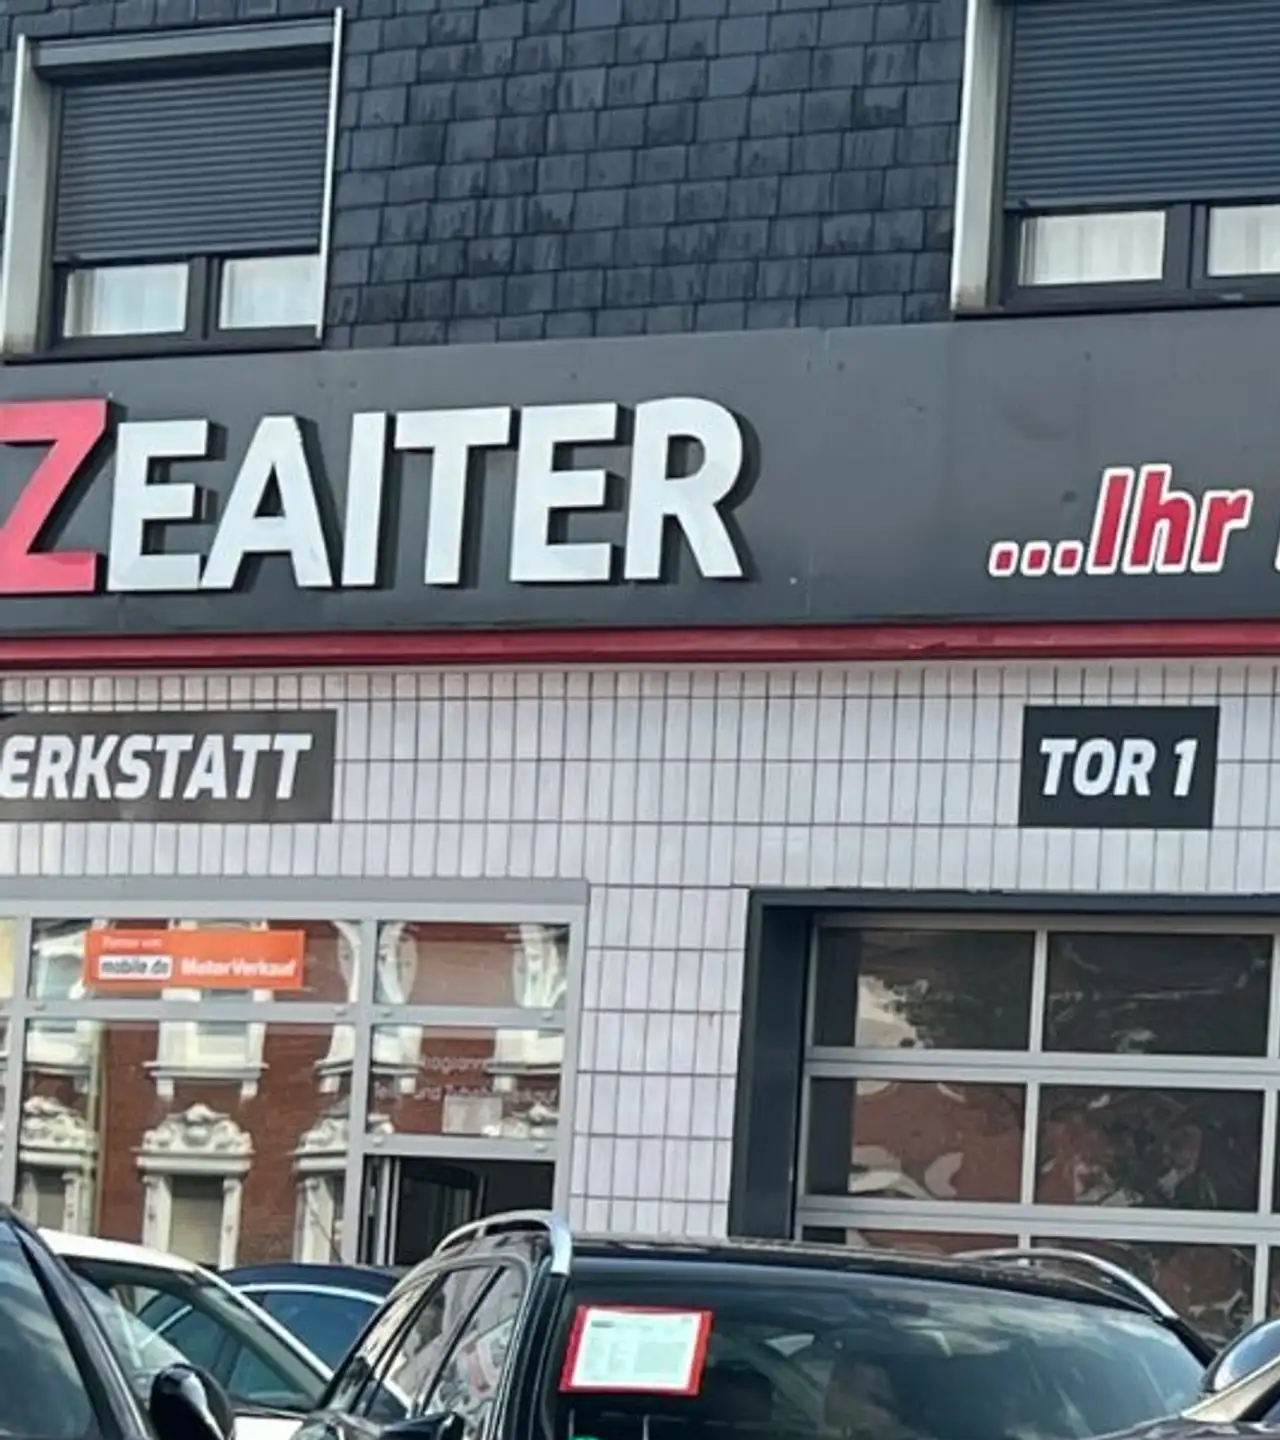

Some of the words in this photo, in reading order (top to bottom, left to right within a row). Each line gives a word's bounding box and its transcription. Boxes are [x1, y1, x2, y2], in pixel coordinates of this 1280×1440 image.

[0, 396, 745, 593] ZEAITER
[0, 734, 312, 800] ERKSTATT
[1040, 738, 1157, 797] TOR
[1173, 738, 1199, 797] 1
